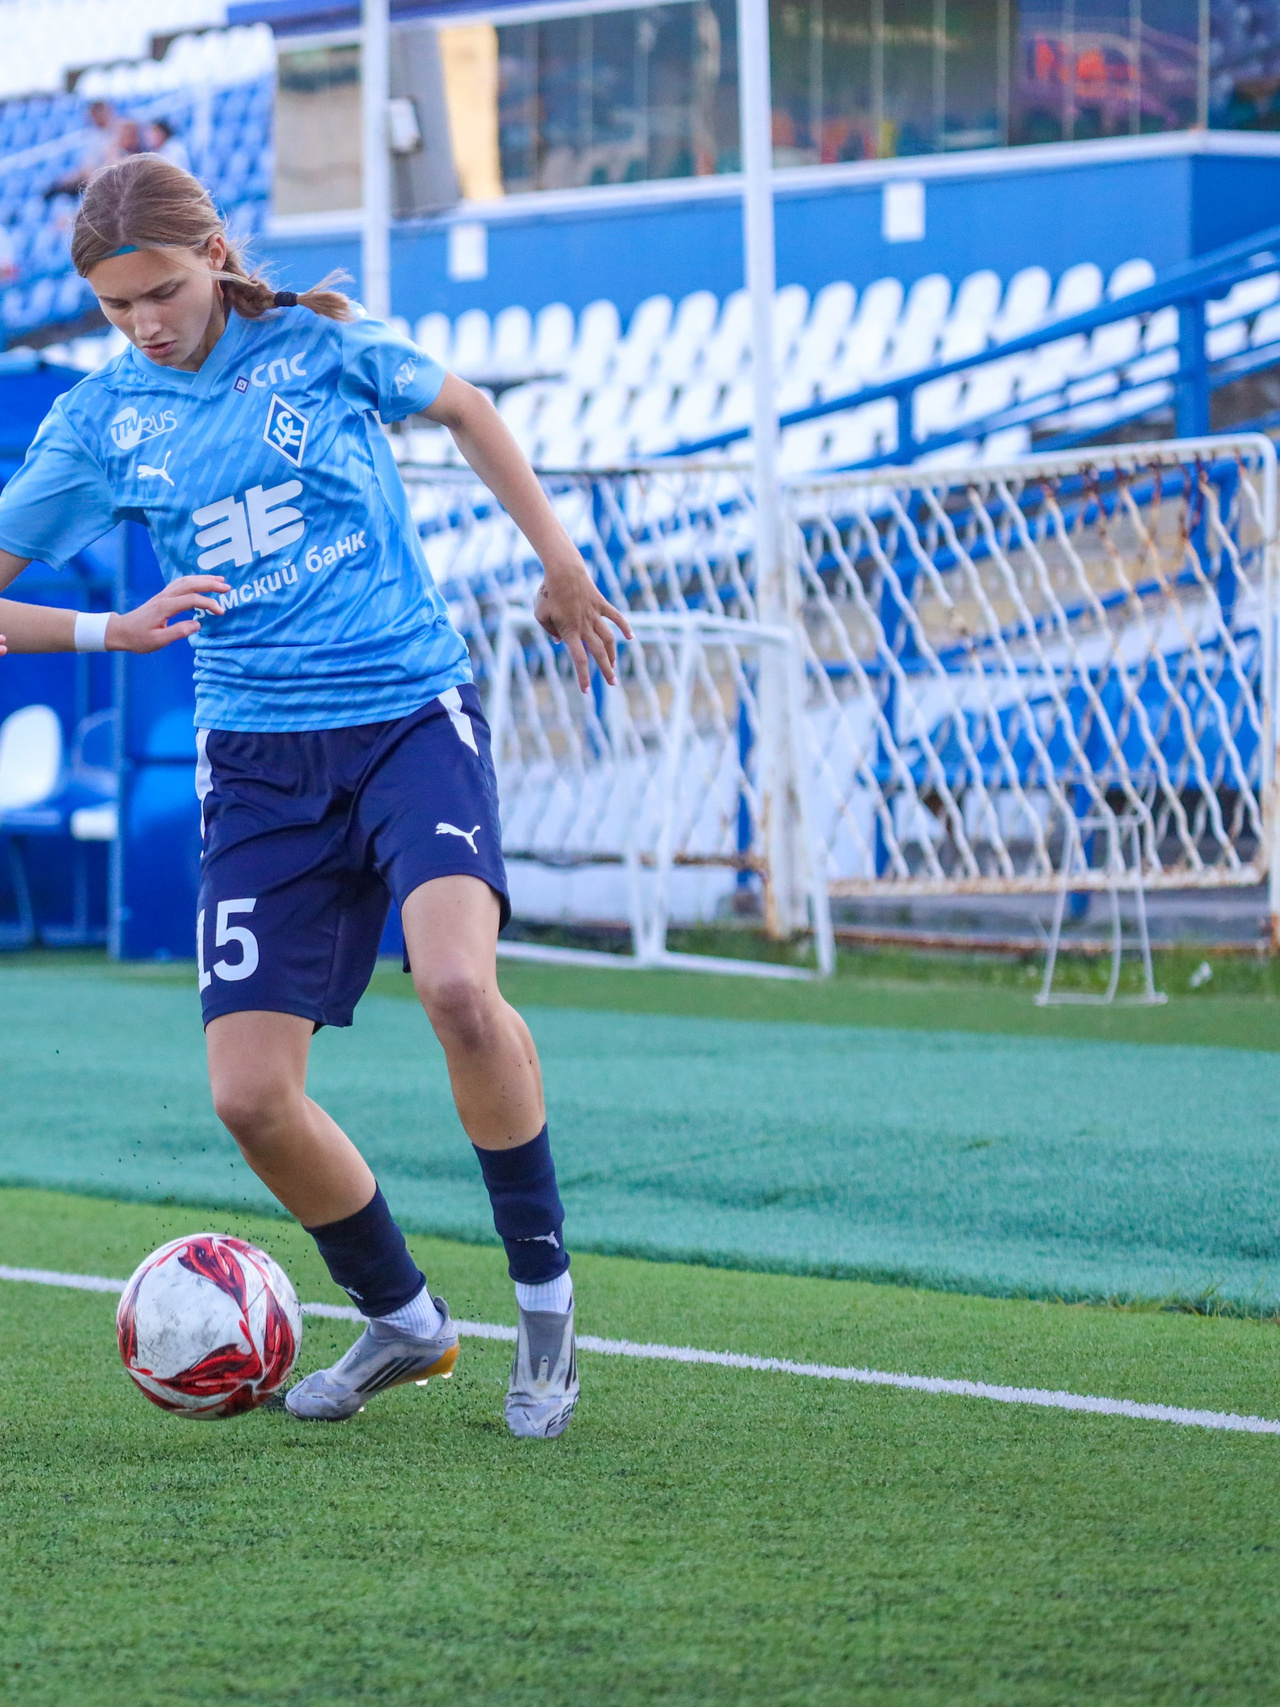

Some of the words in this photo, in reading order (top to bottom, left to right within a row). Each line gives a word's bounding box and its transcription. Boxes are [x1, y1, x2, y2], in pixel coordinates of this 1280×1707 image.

[250, 351, 308, 388] СПС
[305, 530, 367, 573] банк
[196, 897, 261, 994] 15
